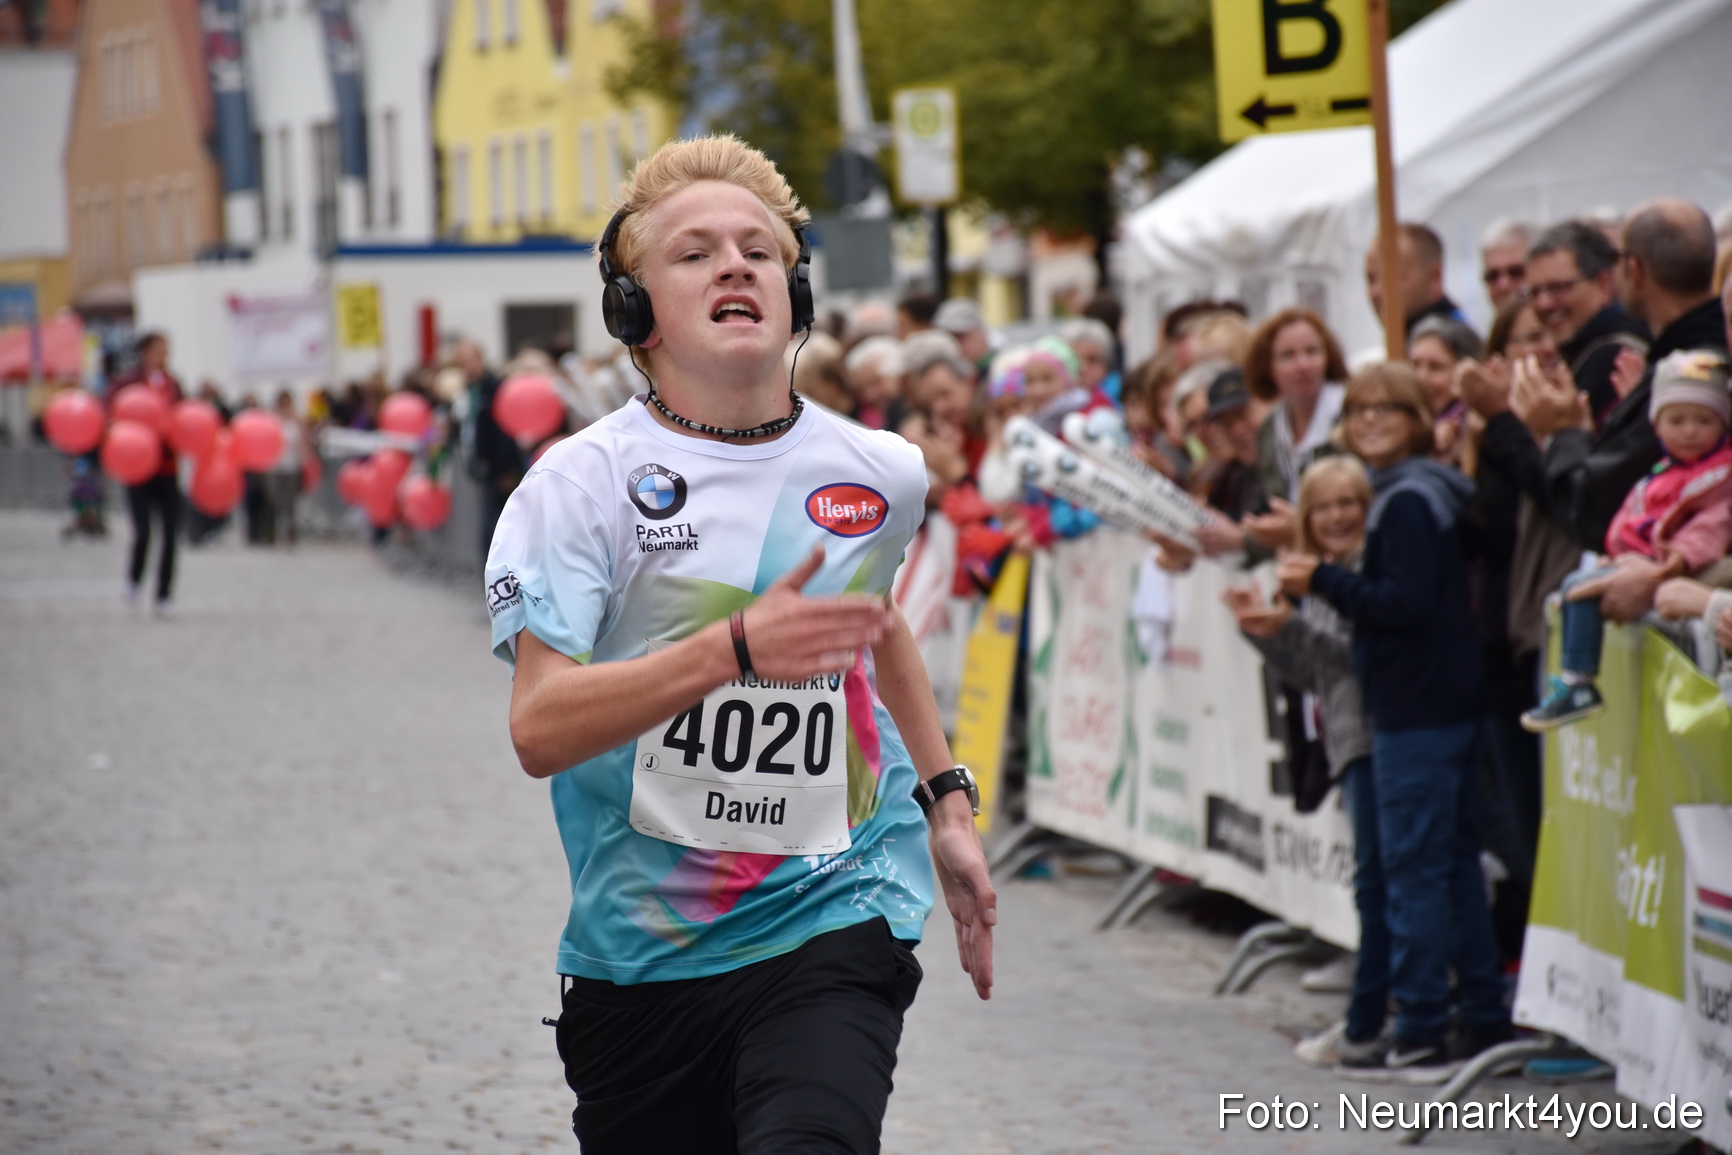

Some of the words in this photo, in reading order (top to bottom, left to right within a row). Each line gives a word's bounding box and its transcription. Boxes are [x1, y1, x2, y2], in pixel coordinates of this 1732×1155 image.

[1263, 0, 1343, 76] B
[629, 464, 680, 485] BMW
[817, 497, 879, 523] Hervis
[636, 523, 699, 540] PARTL
[638, 539, 699, 553] Neumarkt
[662, 698, 834, 776] 4020
[645, 756, 654, 769] J
[705, 791, 786, 825] David
